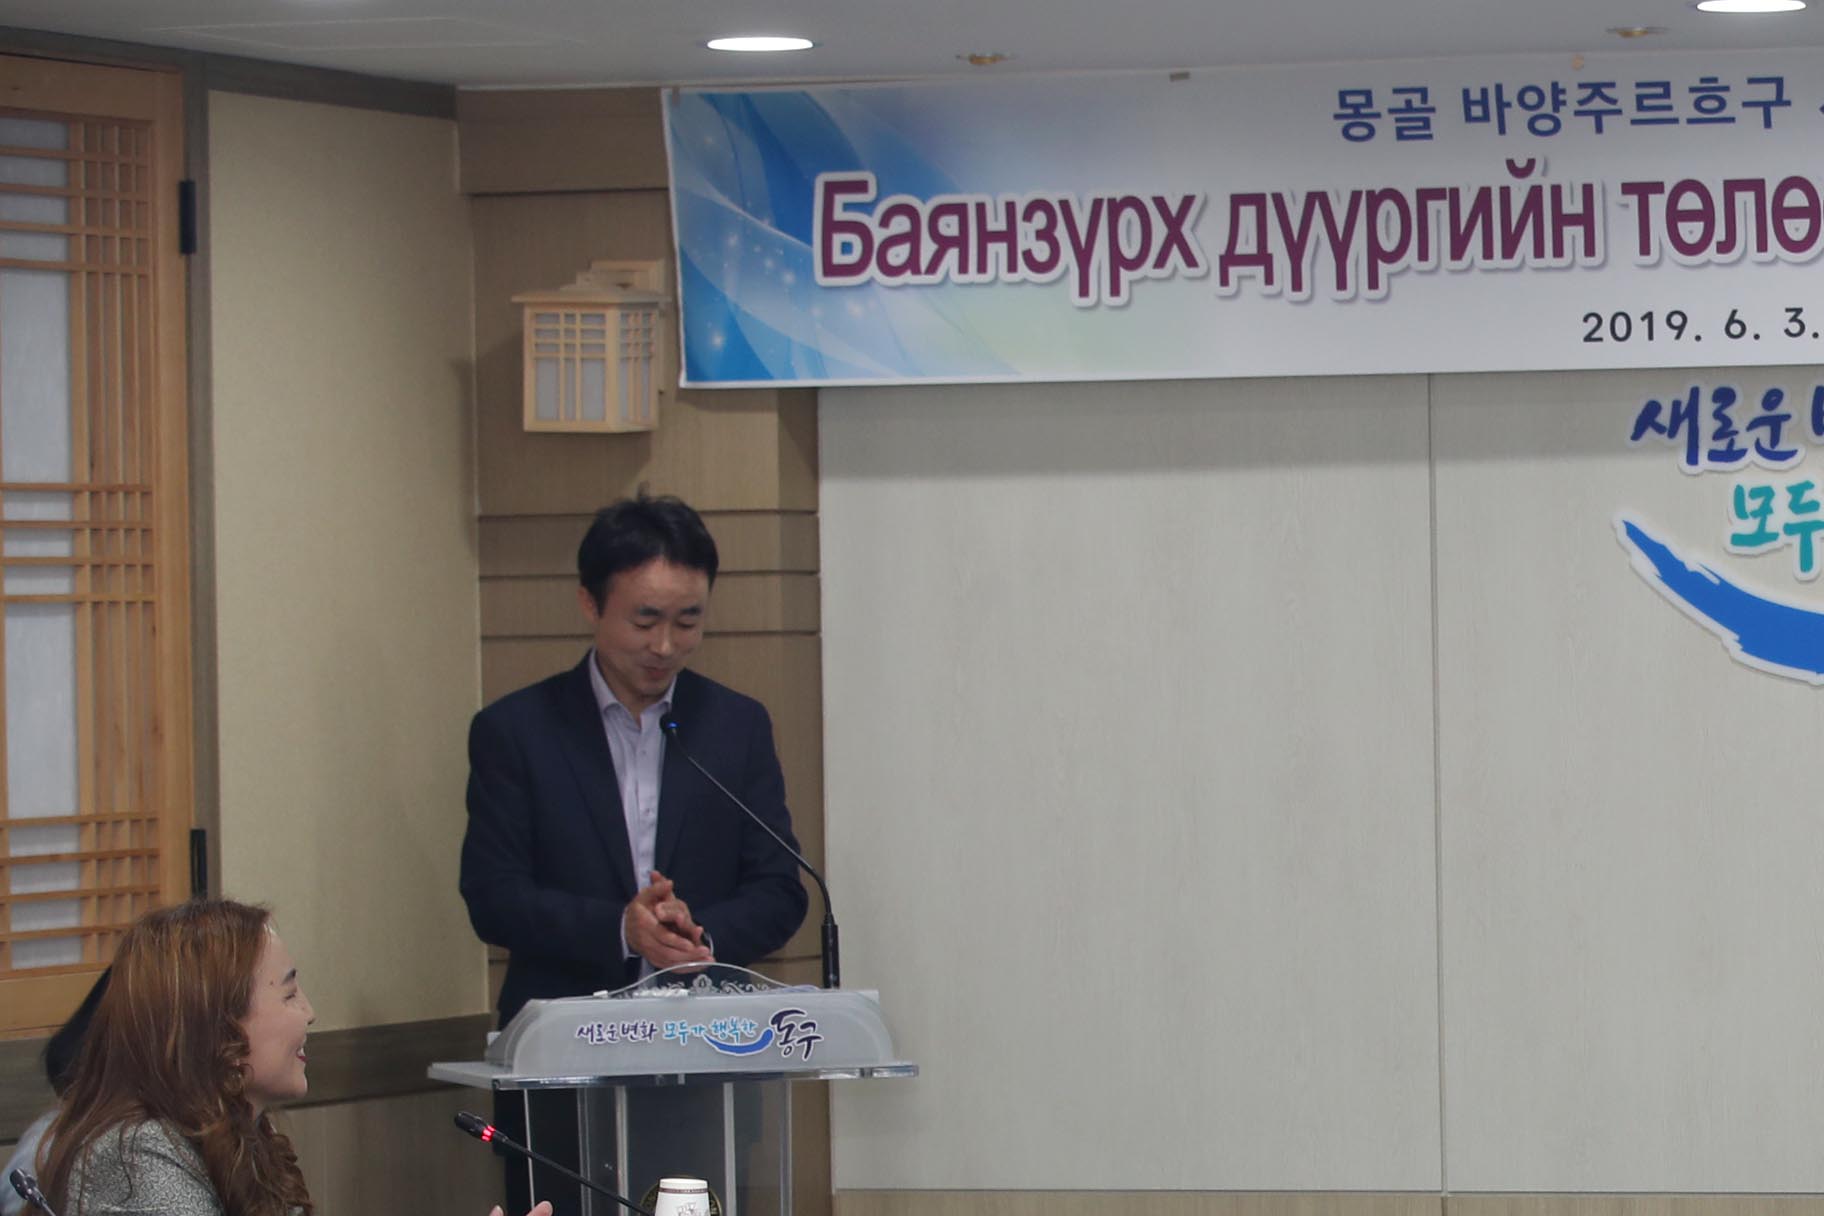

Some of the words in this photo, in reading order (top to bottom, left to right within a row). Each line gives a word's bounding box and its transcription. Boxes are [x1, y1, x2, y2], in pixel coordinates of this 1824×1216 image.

[1333, 86, 1436, 142] 몽골
[1462, 77, 1792, 137] 바양주르흐구
[821, 179, 1199, 298] Баянзүрх
[1218, 158, 1596, 293] дүүргийн
[1582, 310, 1702, 343] 2019.
[1724, 309, 1761, 341] 6.
[1630, 385, 1798, 466] 새로운
[577, 1023, 620, 1043] 새로운
[621, 1021, 657, 1041] 변화
[663, 1021, 705, 1044] 모두가
[710, 1016, 757, 1044] 행복한
[771, 1009, 823, 1060] 동구
